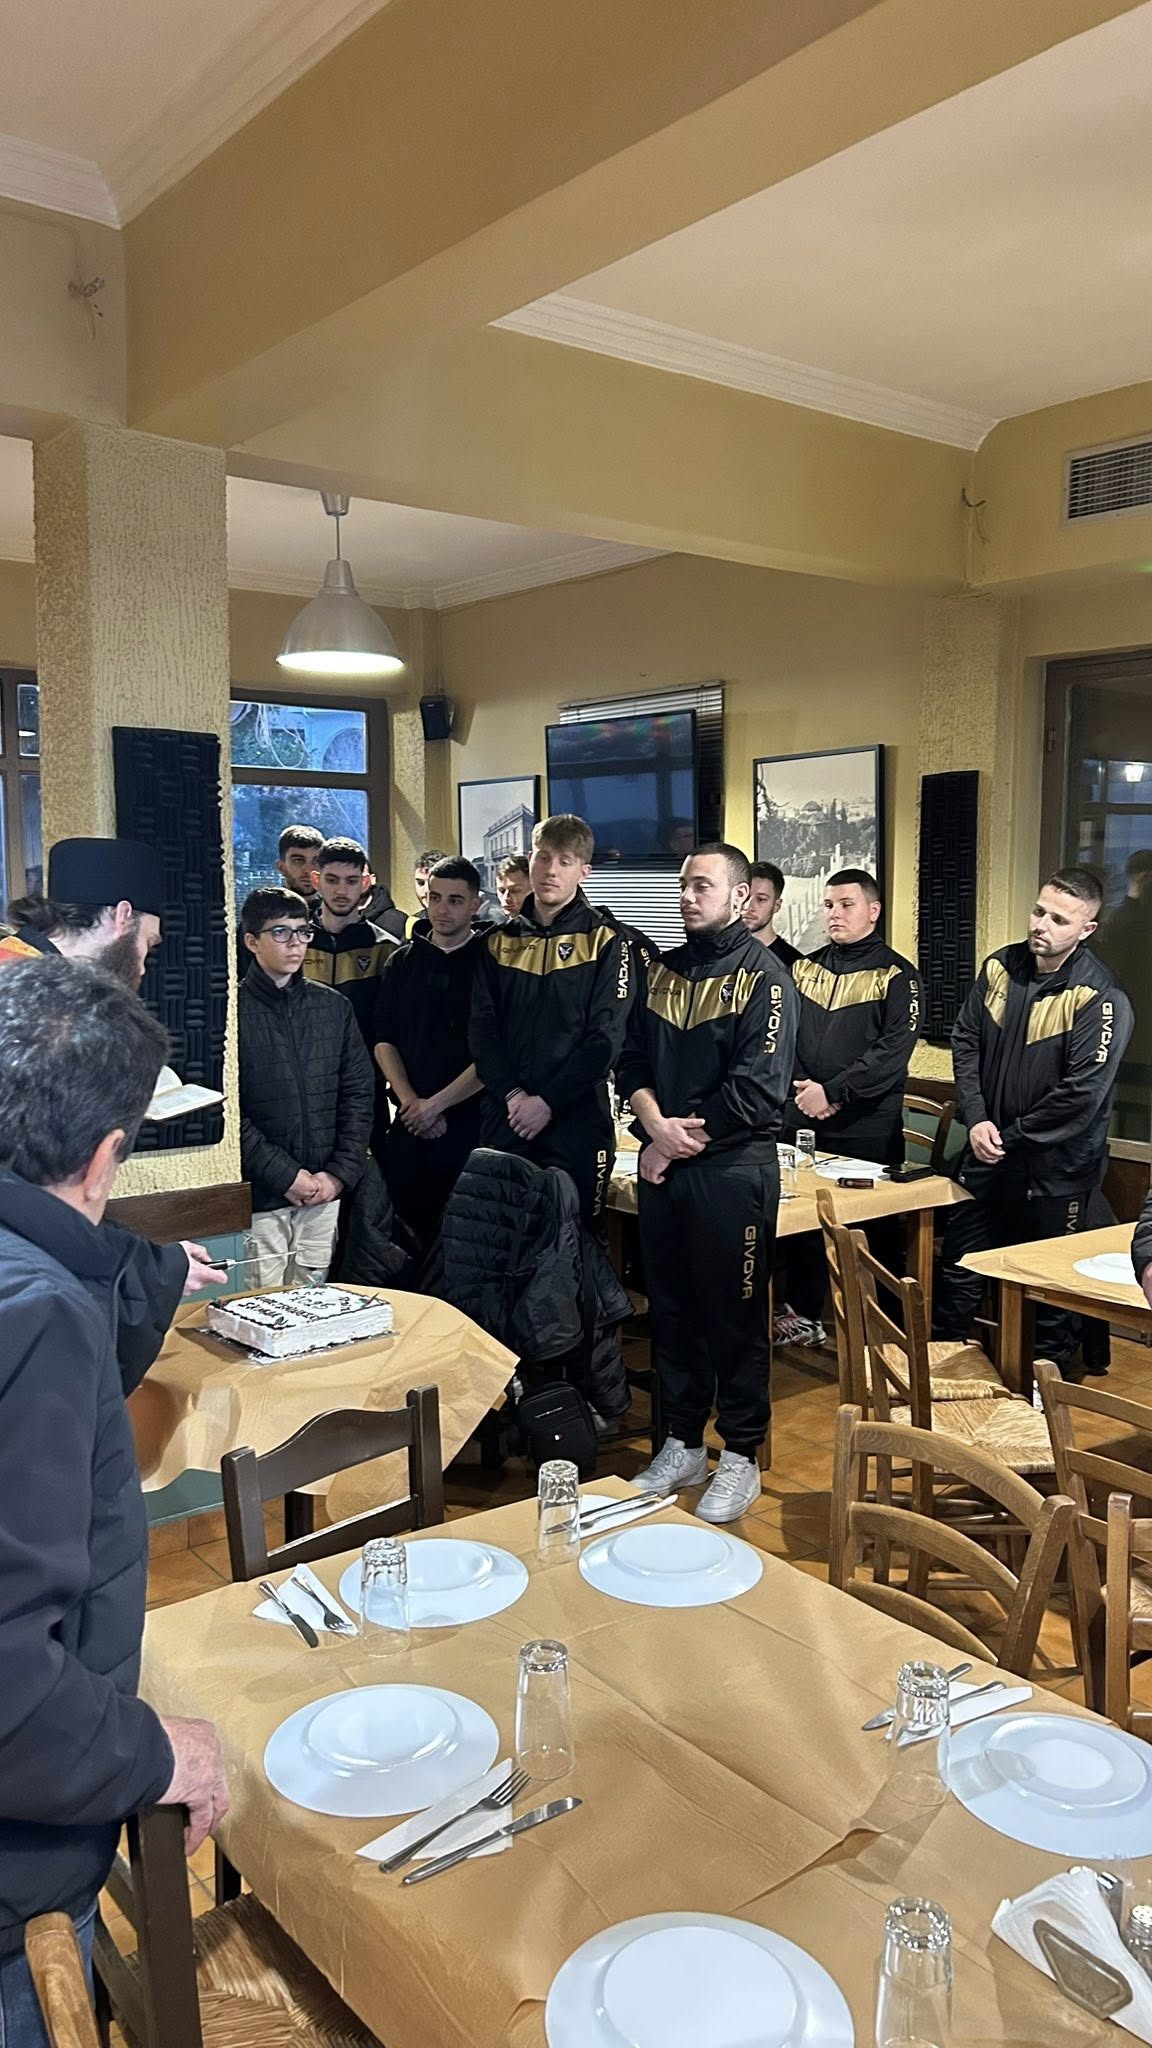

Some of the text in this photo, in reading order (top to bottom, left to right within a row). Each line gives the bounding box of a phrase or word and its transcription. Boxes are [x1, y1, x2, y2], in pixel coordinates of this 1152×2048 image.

[617, 941, 629, 999] GIVOVA
[640, 947, 651, 968] GIV
[764, 985, 782, 1054] GIVOVA
[909, 980, 920, 1031] GIVOVA
[1095, 1001, 1115, 1064] GIVOVA
[592, 1150, 607, 1216] GIVOVA
[1066, 1201, 1079, 1234] GIV
[741, 1225, 757, 1300] GIVOVA
